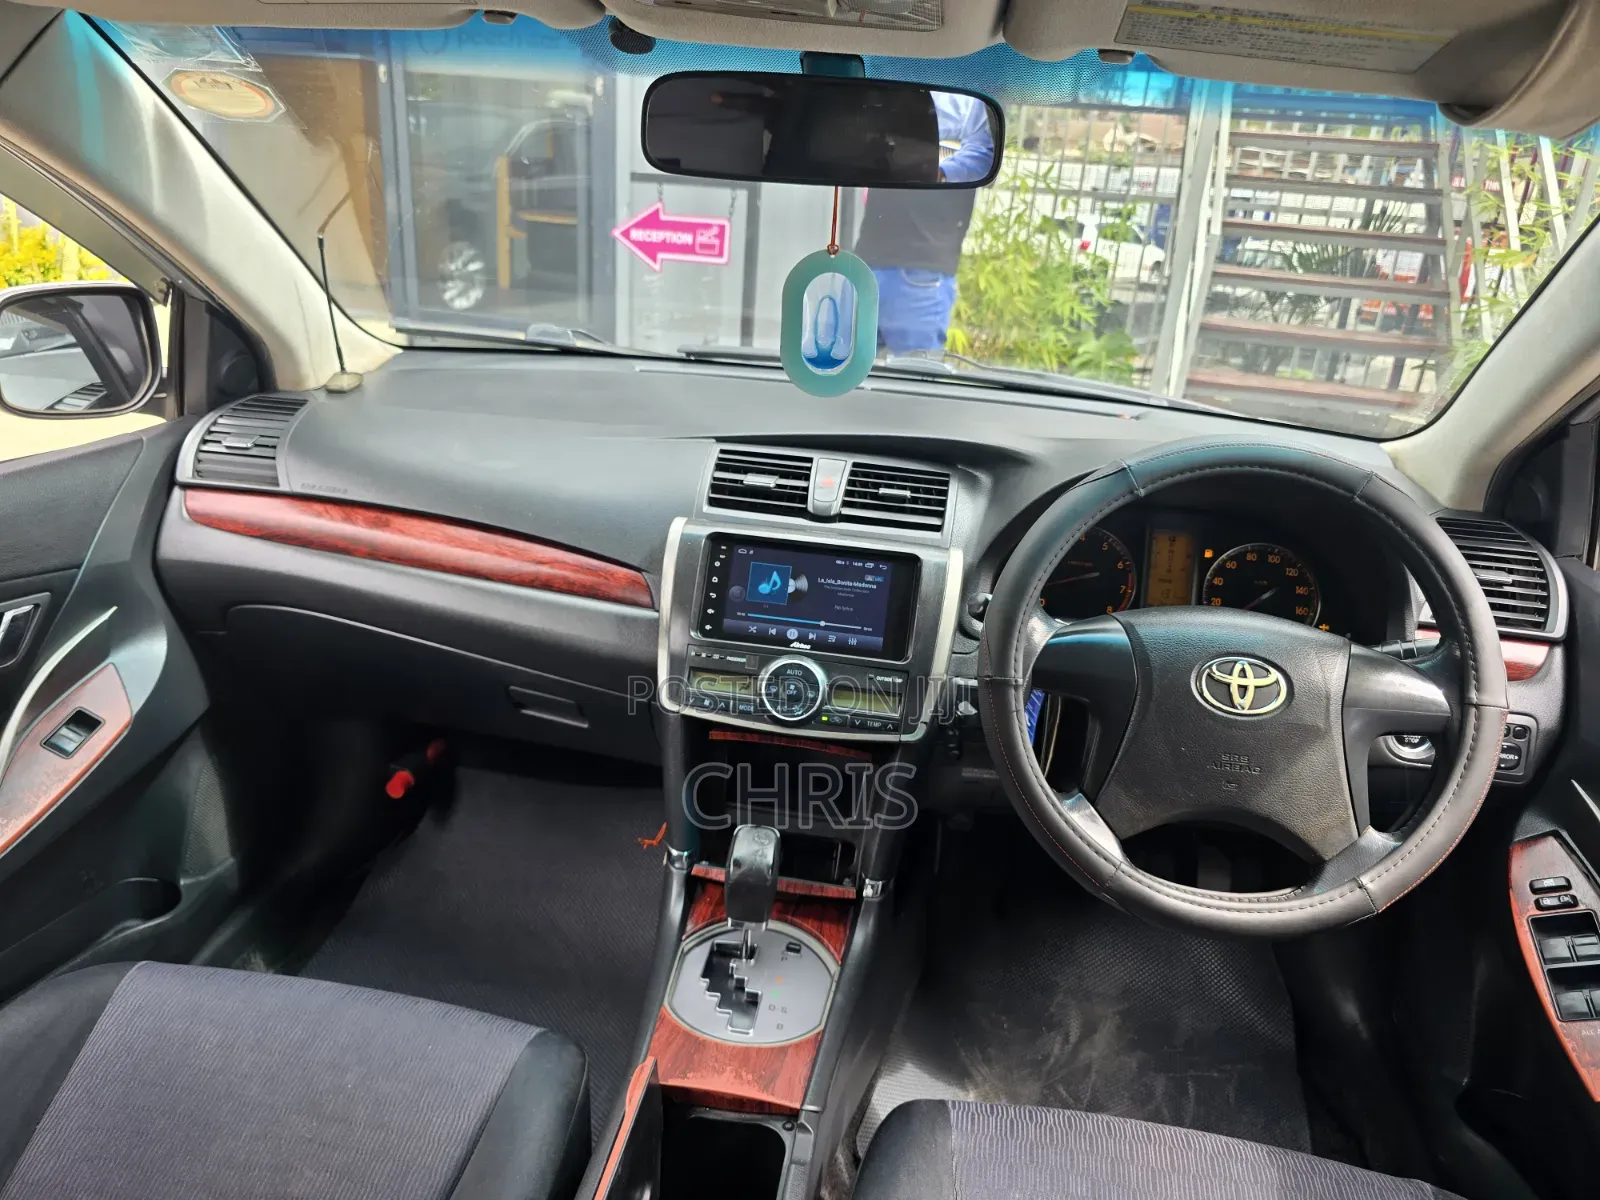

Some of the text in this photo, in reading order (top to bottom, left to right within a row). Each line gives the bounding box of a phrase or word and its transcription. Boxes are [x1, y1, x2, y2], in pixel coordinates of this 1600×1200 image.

[630, 228, 694, 246] RECEPTION
[1102, 542, 1109, 551] 5
[1246, 553, 1257, 561] 80
[1268, 554, 1280, 563] 100
[1226, 560, 1237, 569] 60
[1286, 567, 1299, 576] 120
[1212, 577, 1224, 585] 40
[1120, 585, 1126, 593] 7
[1296, 586, 1308, 595] 140
[1210, 597, 1221, 606] 20
[1106, 606, 1113, 614] 8
[1296, 606, 1308, 615] 160
[739, 704, 754, 712] MODE
[867, 720, 882, 728] TEMP
[1206, 760, 1262, 775] AIRBAG
